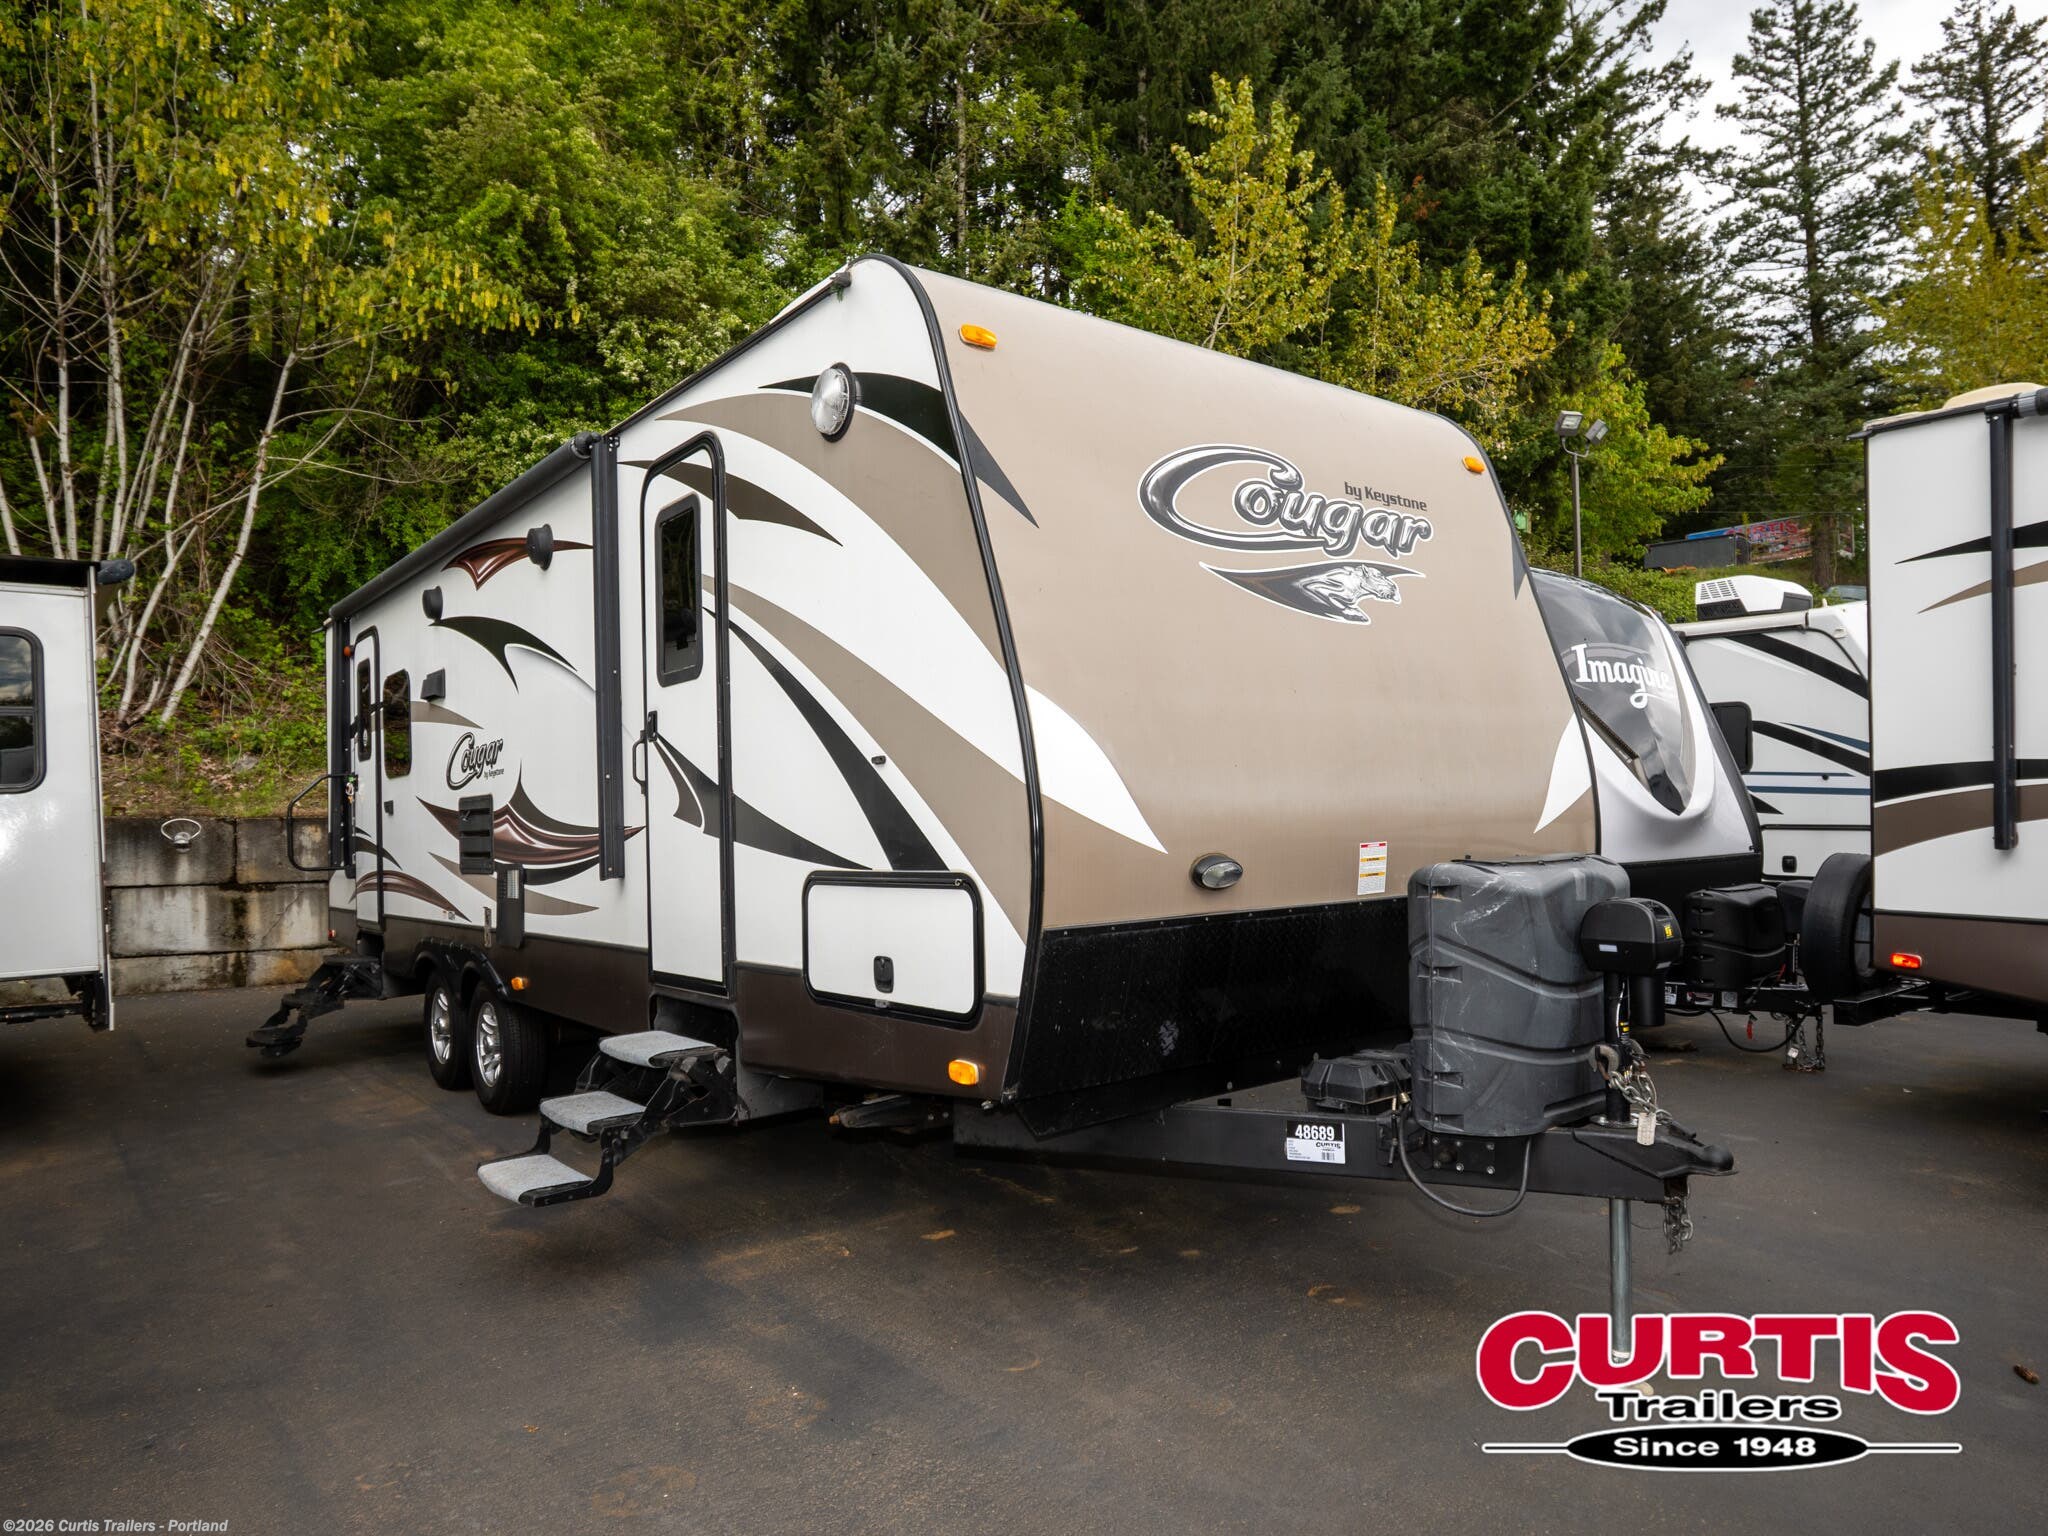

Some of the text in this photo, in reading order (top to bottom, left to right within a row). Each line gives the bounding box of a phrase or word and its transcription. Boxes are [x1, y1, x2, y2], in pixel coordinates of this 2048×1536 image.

[1138, 444, 1433, 558] Cougar
[1344, 482, 1427, 511] by Keystone
[1571, 643, 1670, 709] Imagine
[446, 732, 503, 791] Cougar
[1295, 1124, 1334, 1141] 48689
